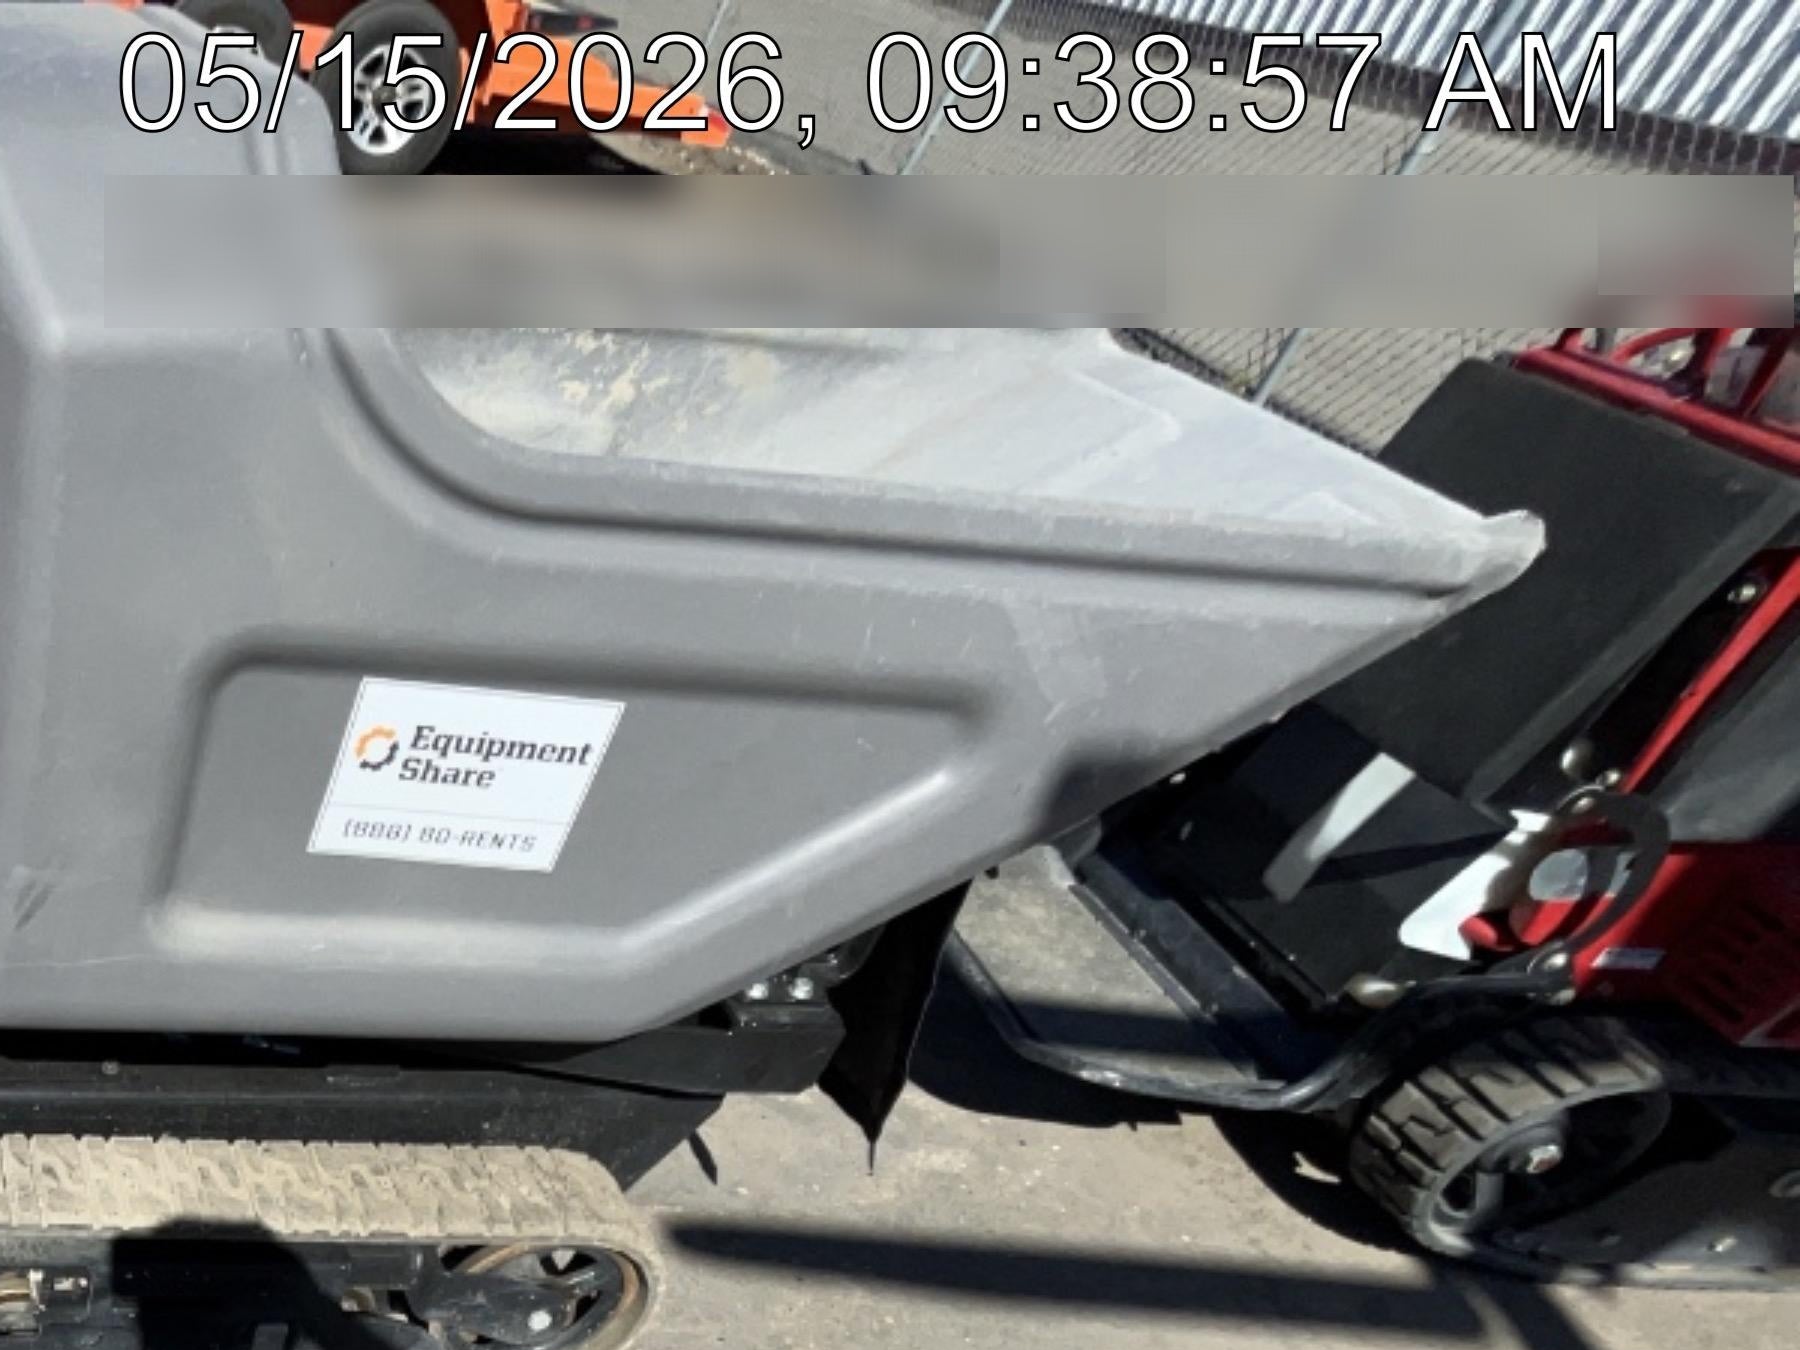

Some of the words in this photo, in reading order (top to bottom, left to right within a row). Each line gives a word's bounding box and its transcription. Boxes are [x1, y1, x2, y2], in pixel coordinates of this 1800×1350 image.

[410, 725, 594, 767] Equipment
[399, 757, 496, 789] Share
[343, 818, 412, 843] (888)
[419, 826, 537, 852] 80-RENTS
